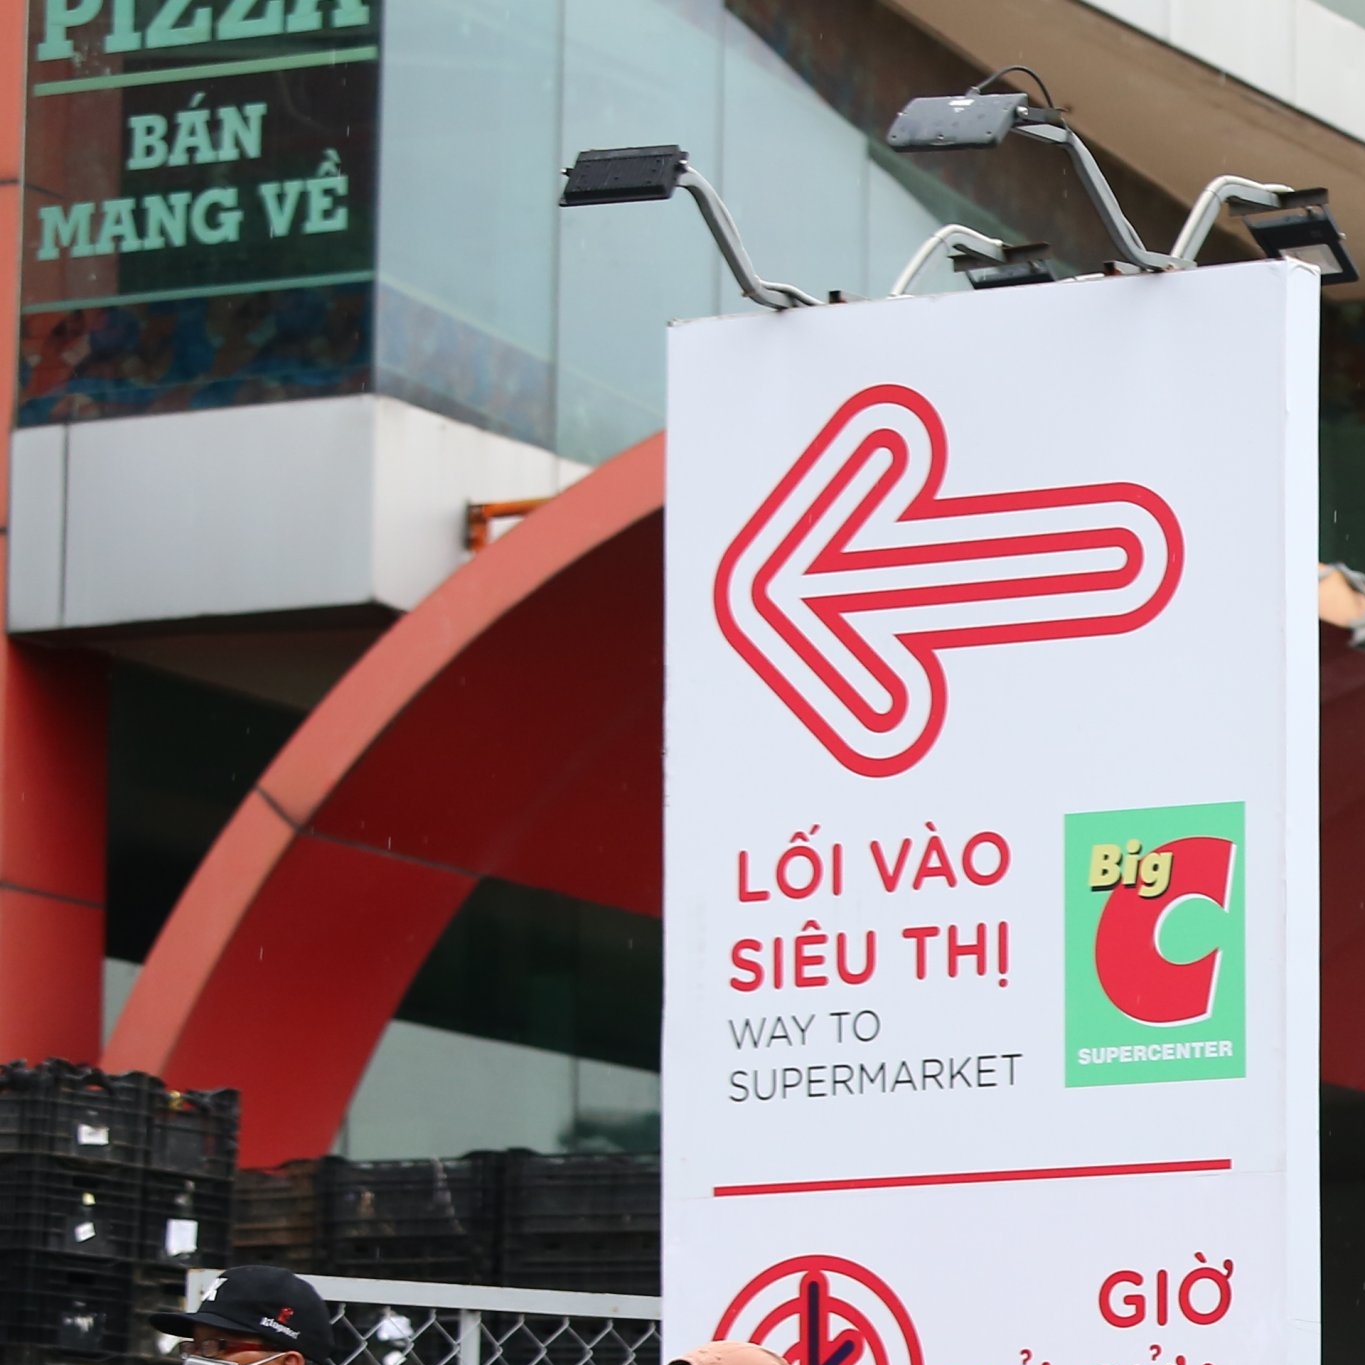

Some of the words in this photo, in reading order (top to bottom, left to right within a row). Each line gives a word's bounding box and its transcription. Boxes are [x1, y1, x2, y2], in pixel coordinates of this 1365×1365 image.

[127, 93, 268, 171] BÁN
[37, 187, 244, 261] MANG
[259, 149, 348, 238] VỀ
[738, 824, 843, 902] LỐI
[870, 821, 1012, 893] VÀO
[1088, 839, 1173, 899] Big
[729, 919, 877, 993] SIÊU
[902, 920, 1010, 988] THỊ
[728, 1014, 817, 1051] WAY
[829, 1009, 881, 1043] TO
[1077, 1039, 1234, 1065] SUPERCENTER
[728, 1053, 1023, 1102] SUPERMARKET
[1099, 1252, 1234, 1329] GIỜ
